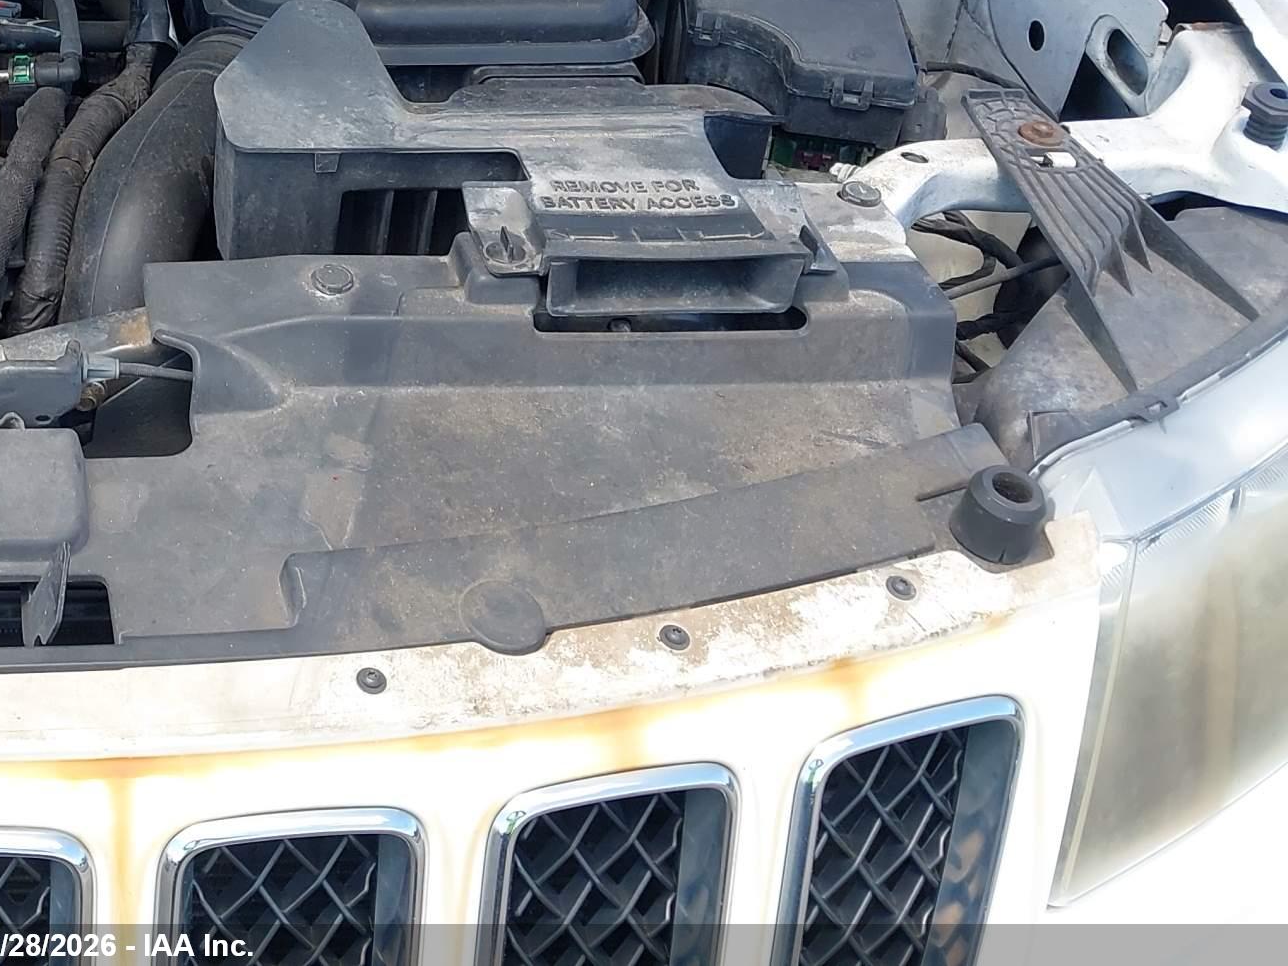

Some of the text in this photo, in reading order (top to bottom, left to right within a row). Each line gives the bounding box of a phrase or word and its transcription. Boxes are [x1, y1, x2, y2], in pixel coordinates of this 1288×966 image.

[550, 179, 700, 194] REMOVE FOR
[540, 194, 736, 210] BATTERY ACCESS
